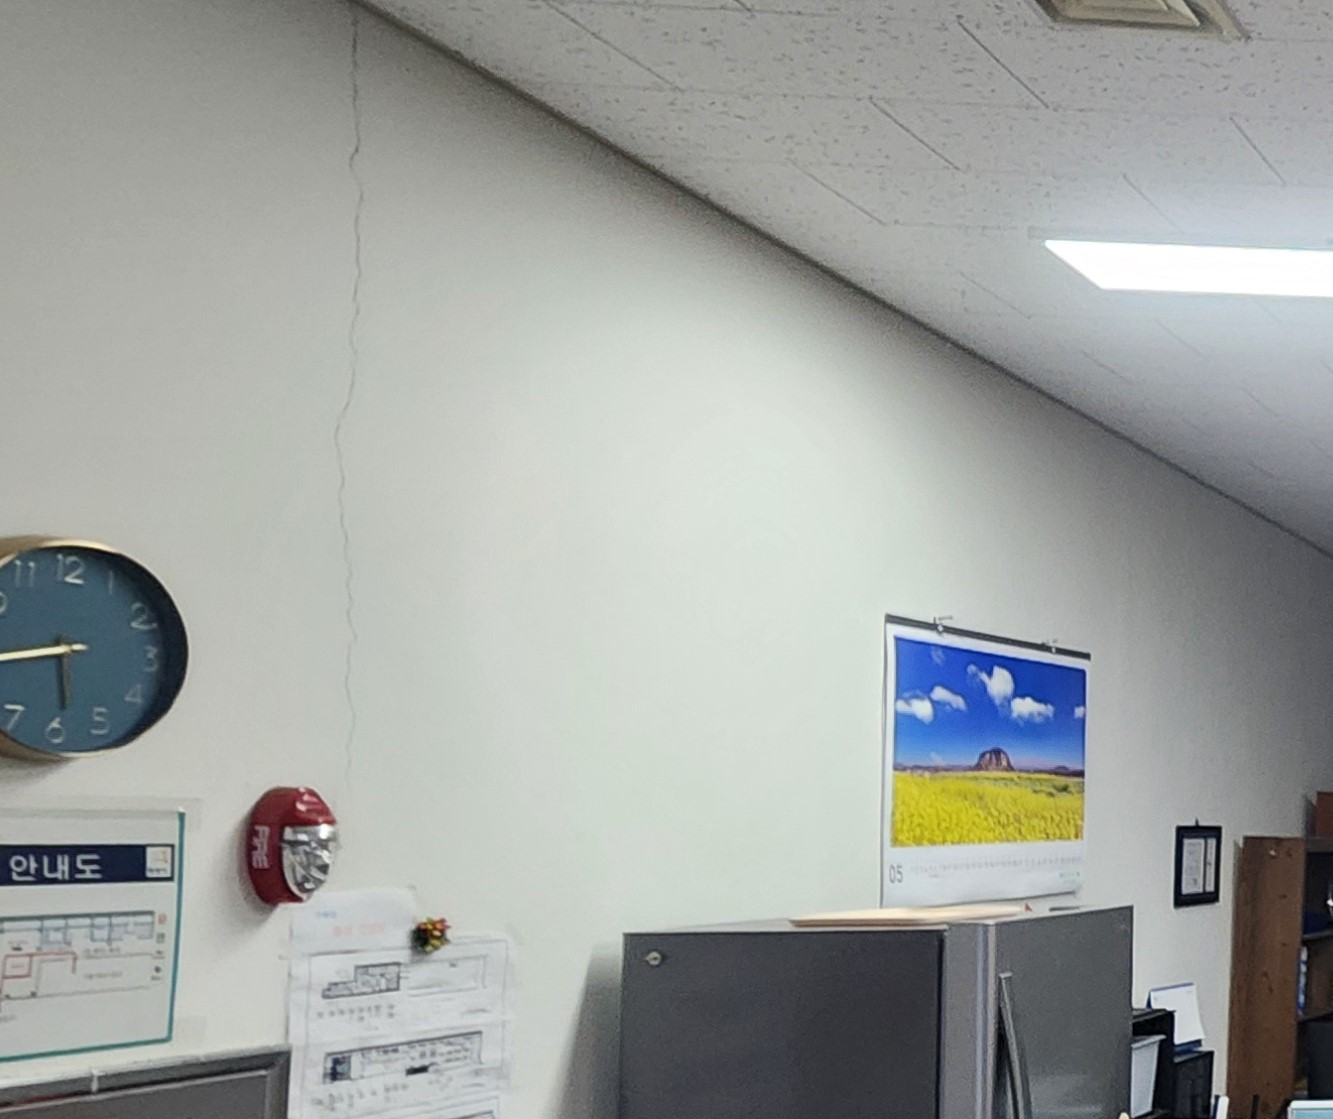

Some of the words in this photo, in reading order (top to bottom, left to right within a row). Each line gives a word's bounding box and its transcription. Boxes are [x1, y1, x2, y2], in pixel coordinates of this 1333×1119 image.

[14, 559, 36, 587] 11
[56, 553, 84, 585] 12
[107, 570, 115, 595] 1
[130, 602, 158, 630] 2
[143, 645, 159, 672] 3
[124, 683, 143, 703] 4
[3, 704, 26, 731] 7
[45, 717, 66, 744] 6
[90, 706, 109, 735] 5
[251, 825, 271, 870] FIRE
[9, 852, 103, 882] 안내도
[889, 864, 904, 884] 05
